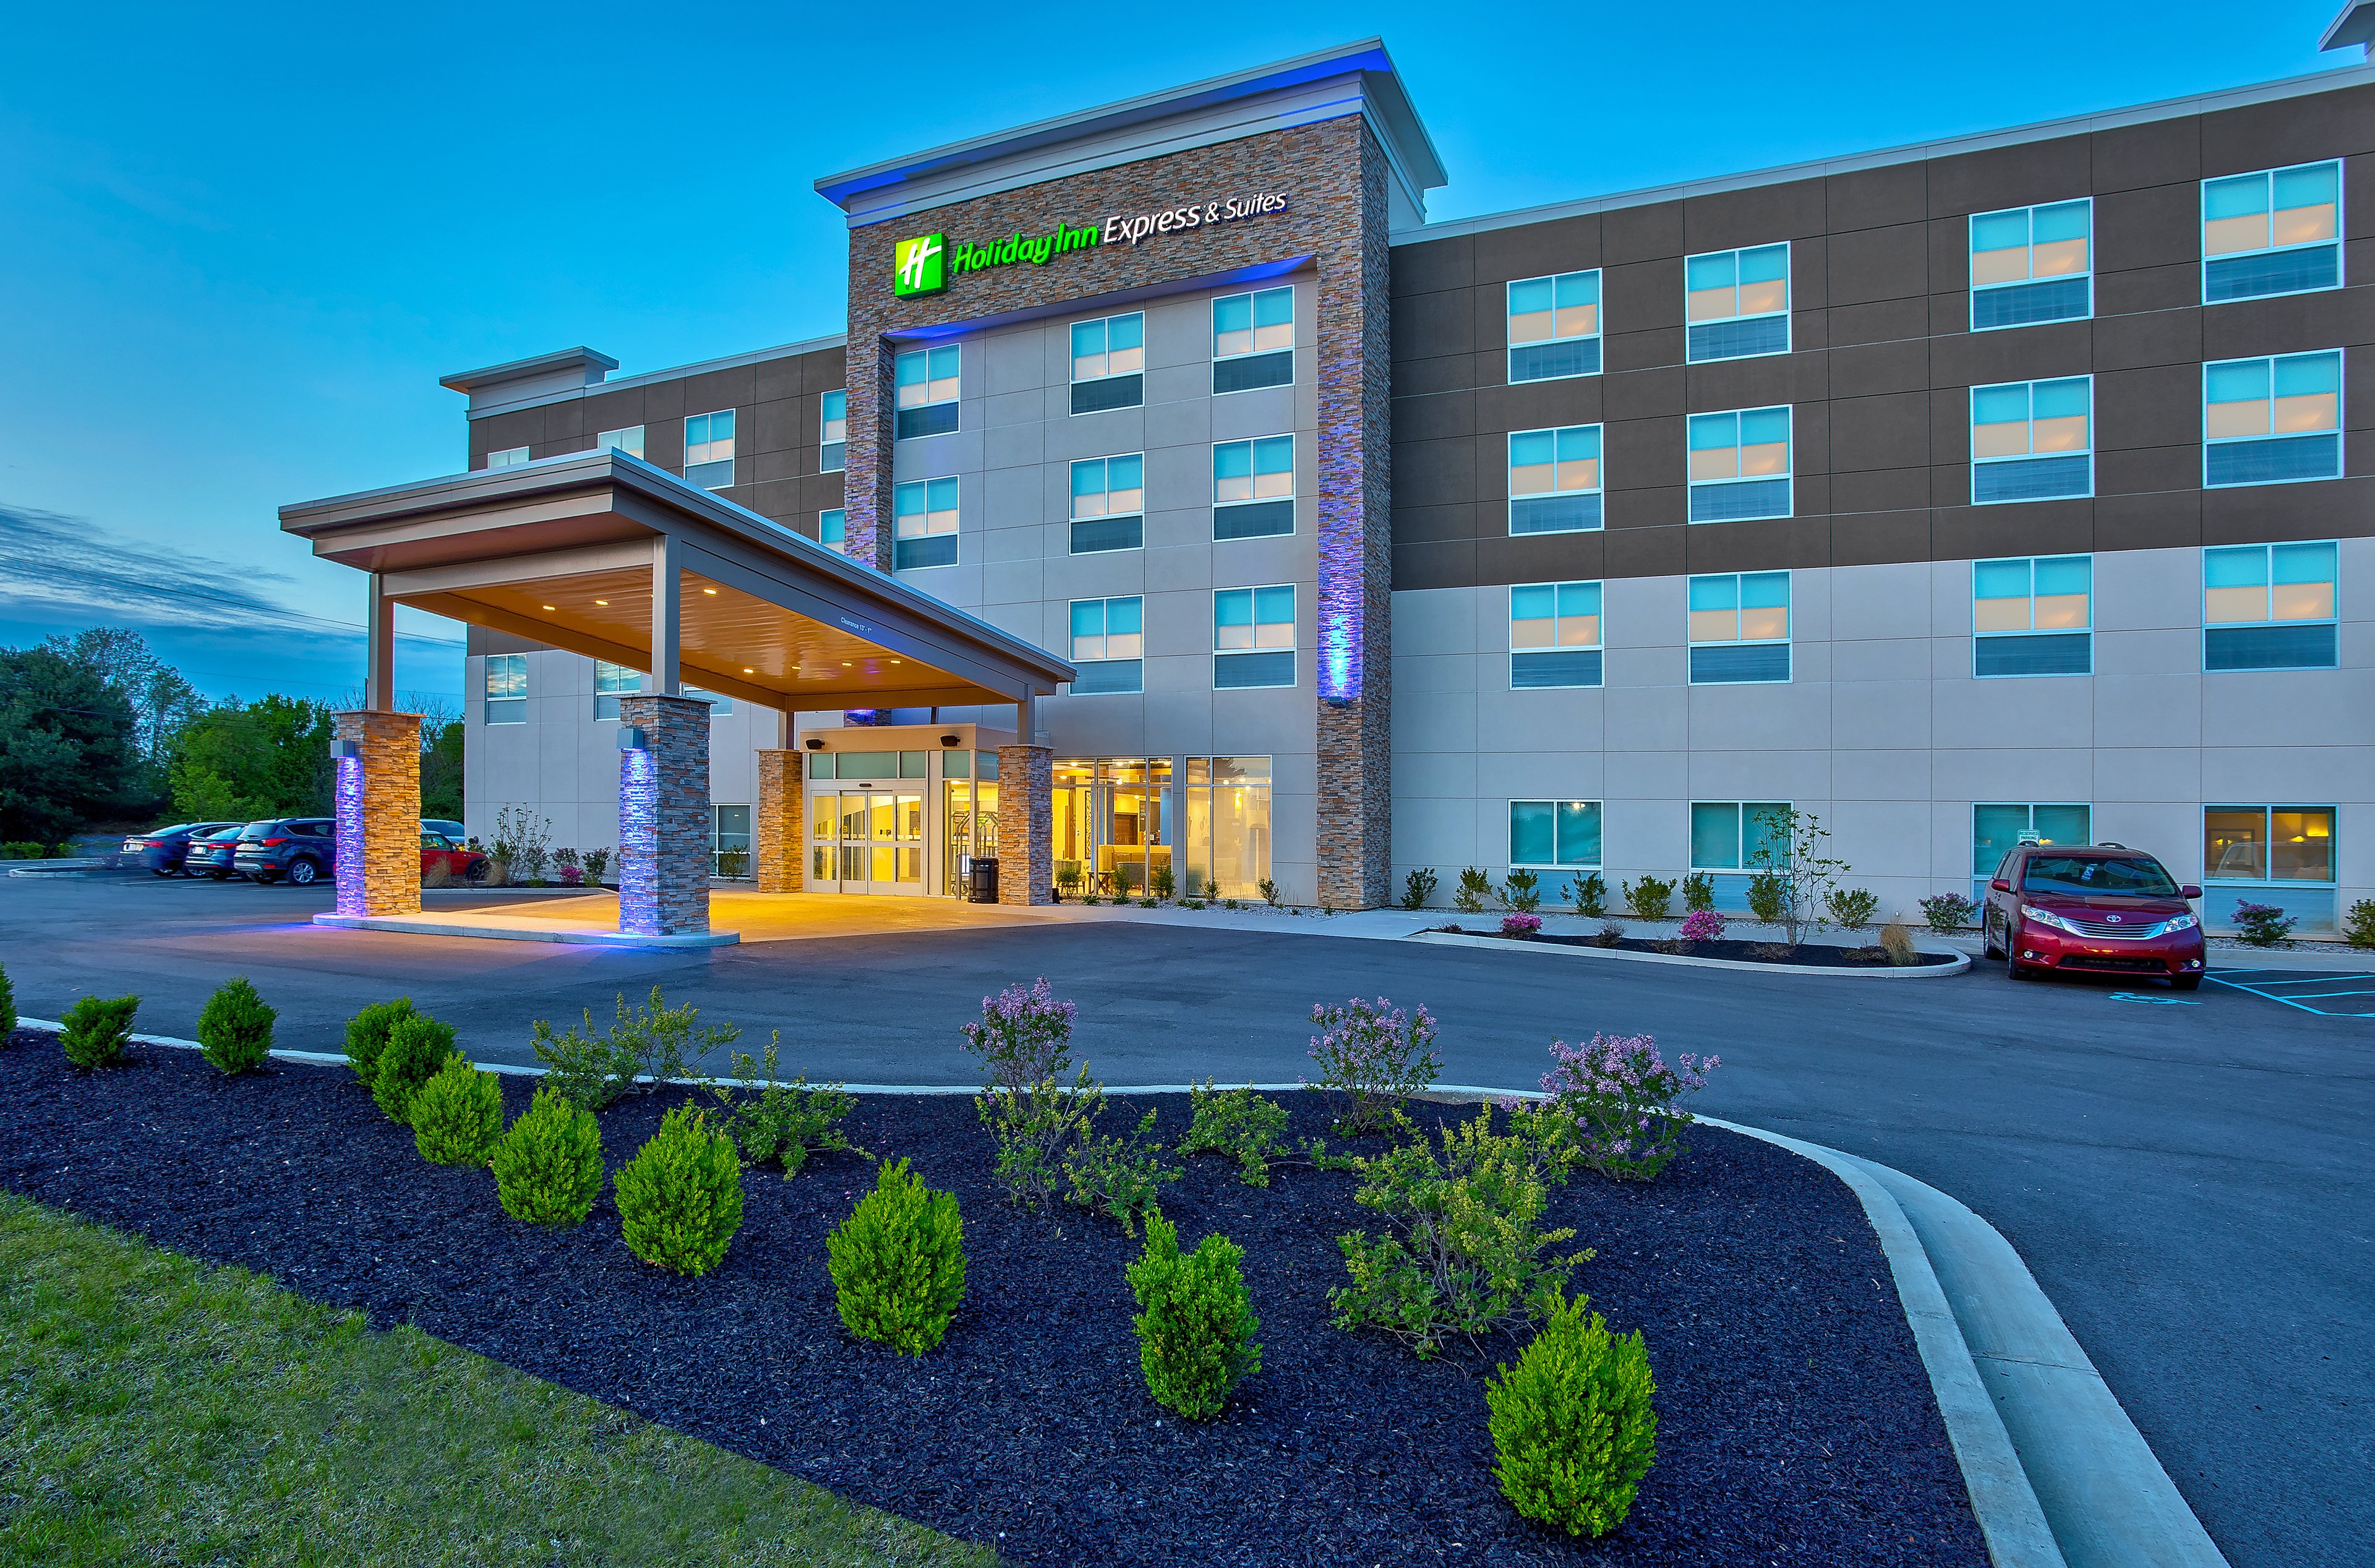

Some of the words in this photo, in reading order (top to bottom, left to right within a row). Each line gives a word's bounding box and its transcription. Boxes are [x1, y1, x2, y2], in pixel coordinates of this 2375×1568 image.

[952, 233, 1053, 274] Holiday
[1055, 222, 1100, 254] Inn
[1104, 205, 1201, 246] Express
[1205, 202, 1220, 224] &
[1224, 192, 1286, 220] Suites
[841, 617, 859, 629] Clearance
